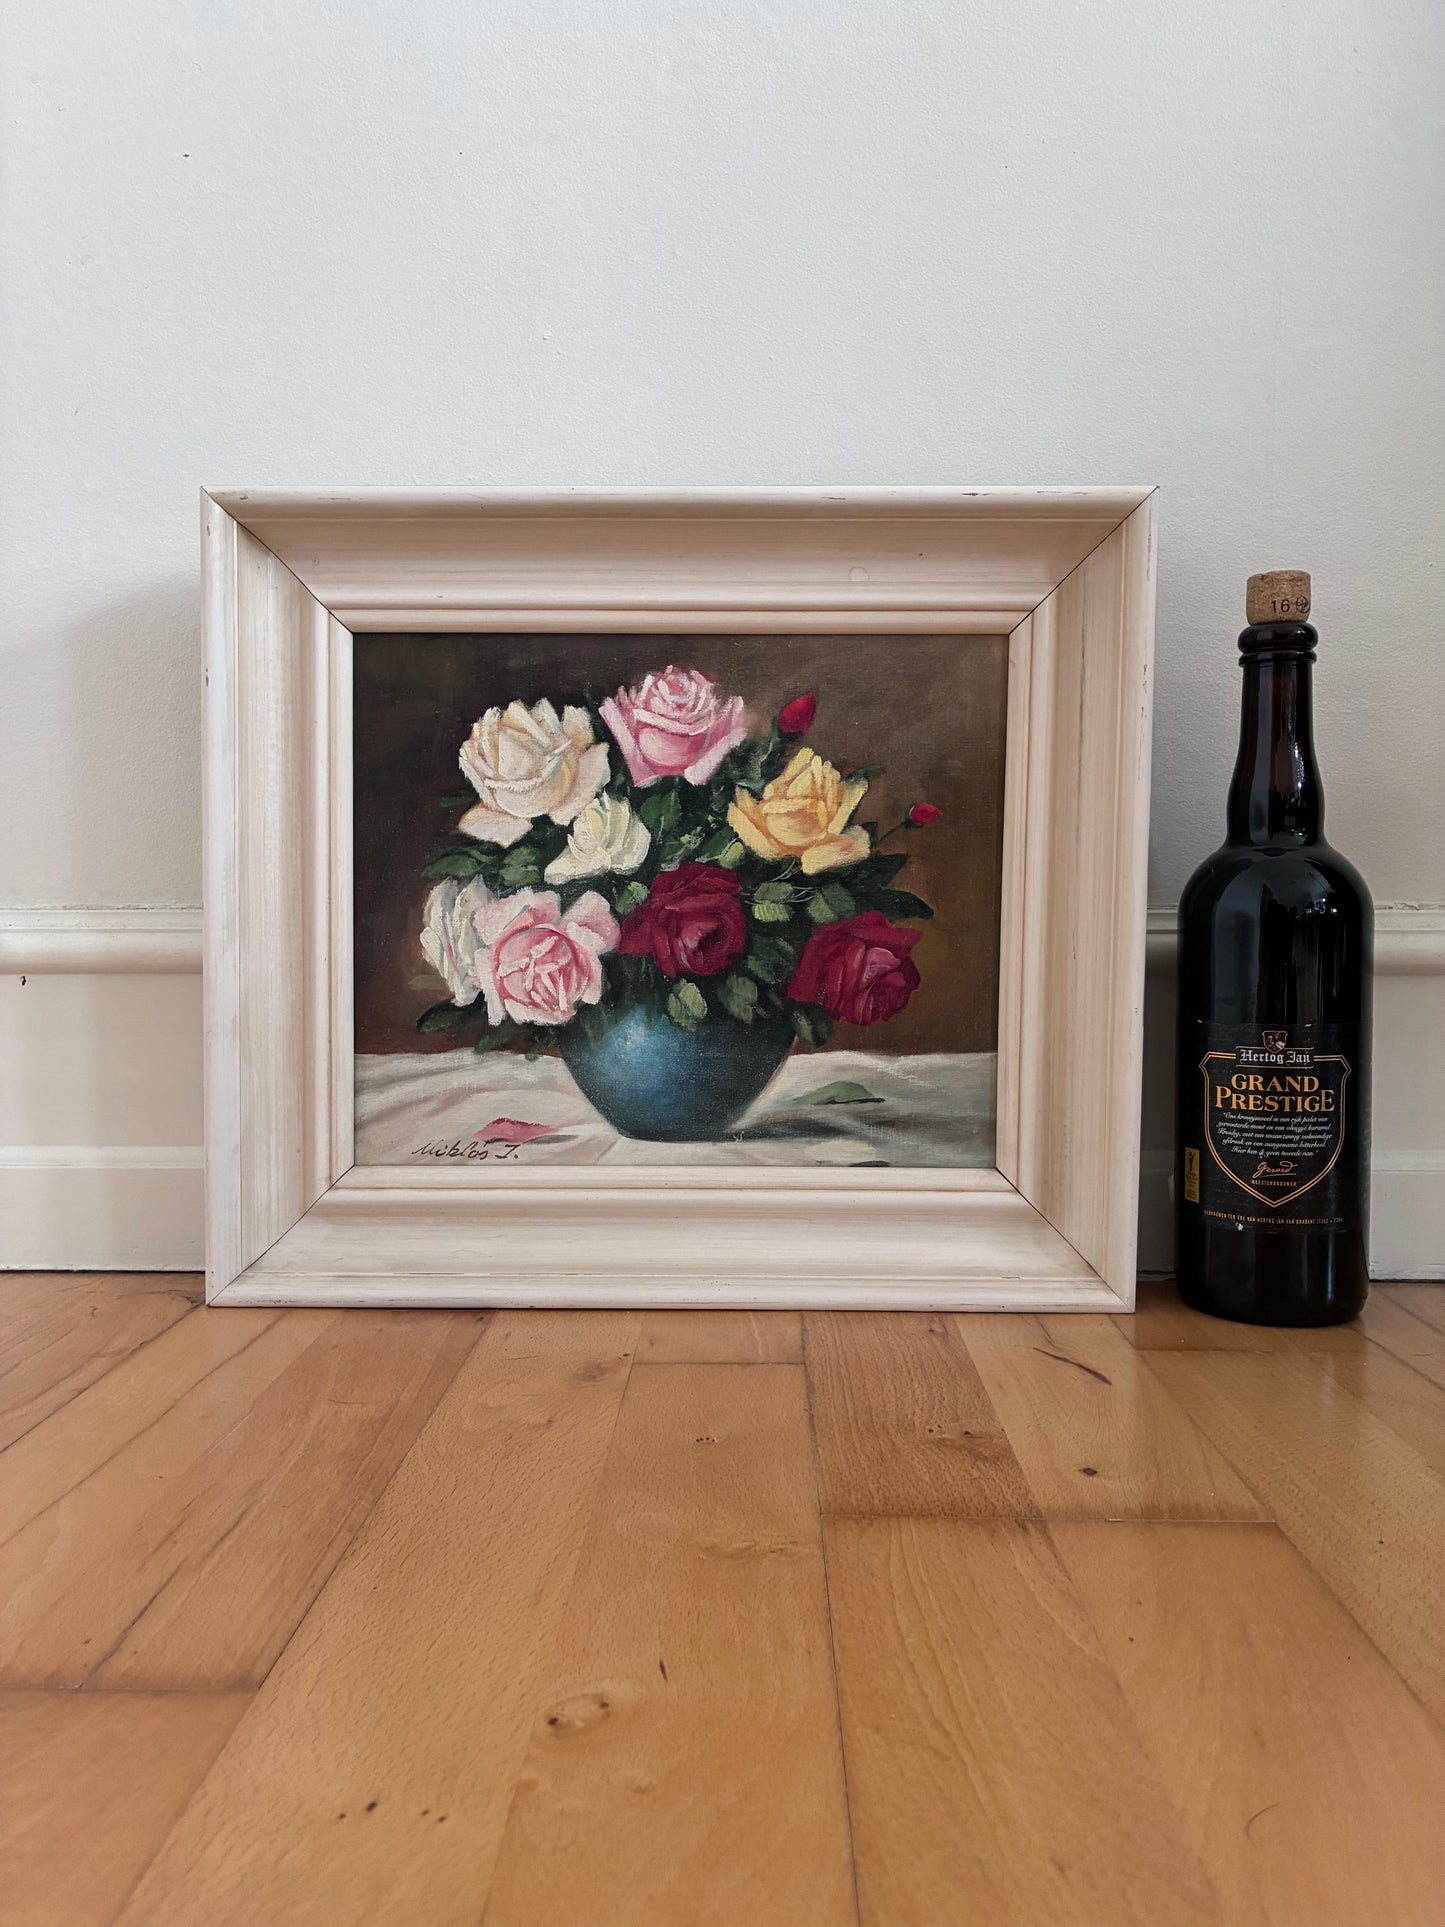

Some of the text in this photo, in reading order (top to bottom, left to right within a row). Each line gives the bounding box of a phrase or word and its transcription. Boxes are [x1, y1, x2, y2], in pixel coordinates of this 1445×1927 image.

[1270, 599, 1291, 614] 16
[1240, 1049, 1311, 1065] Hertog Jan
[1231, 1073, 1320, 1093] GRAND
[1215, 1085, 1335, 1112] PRESTIGE
